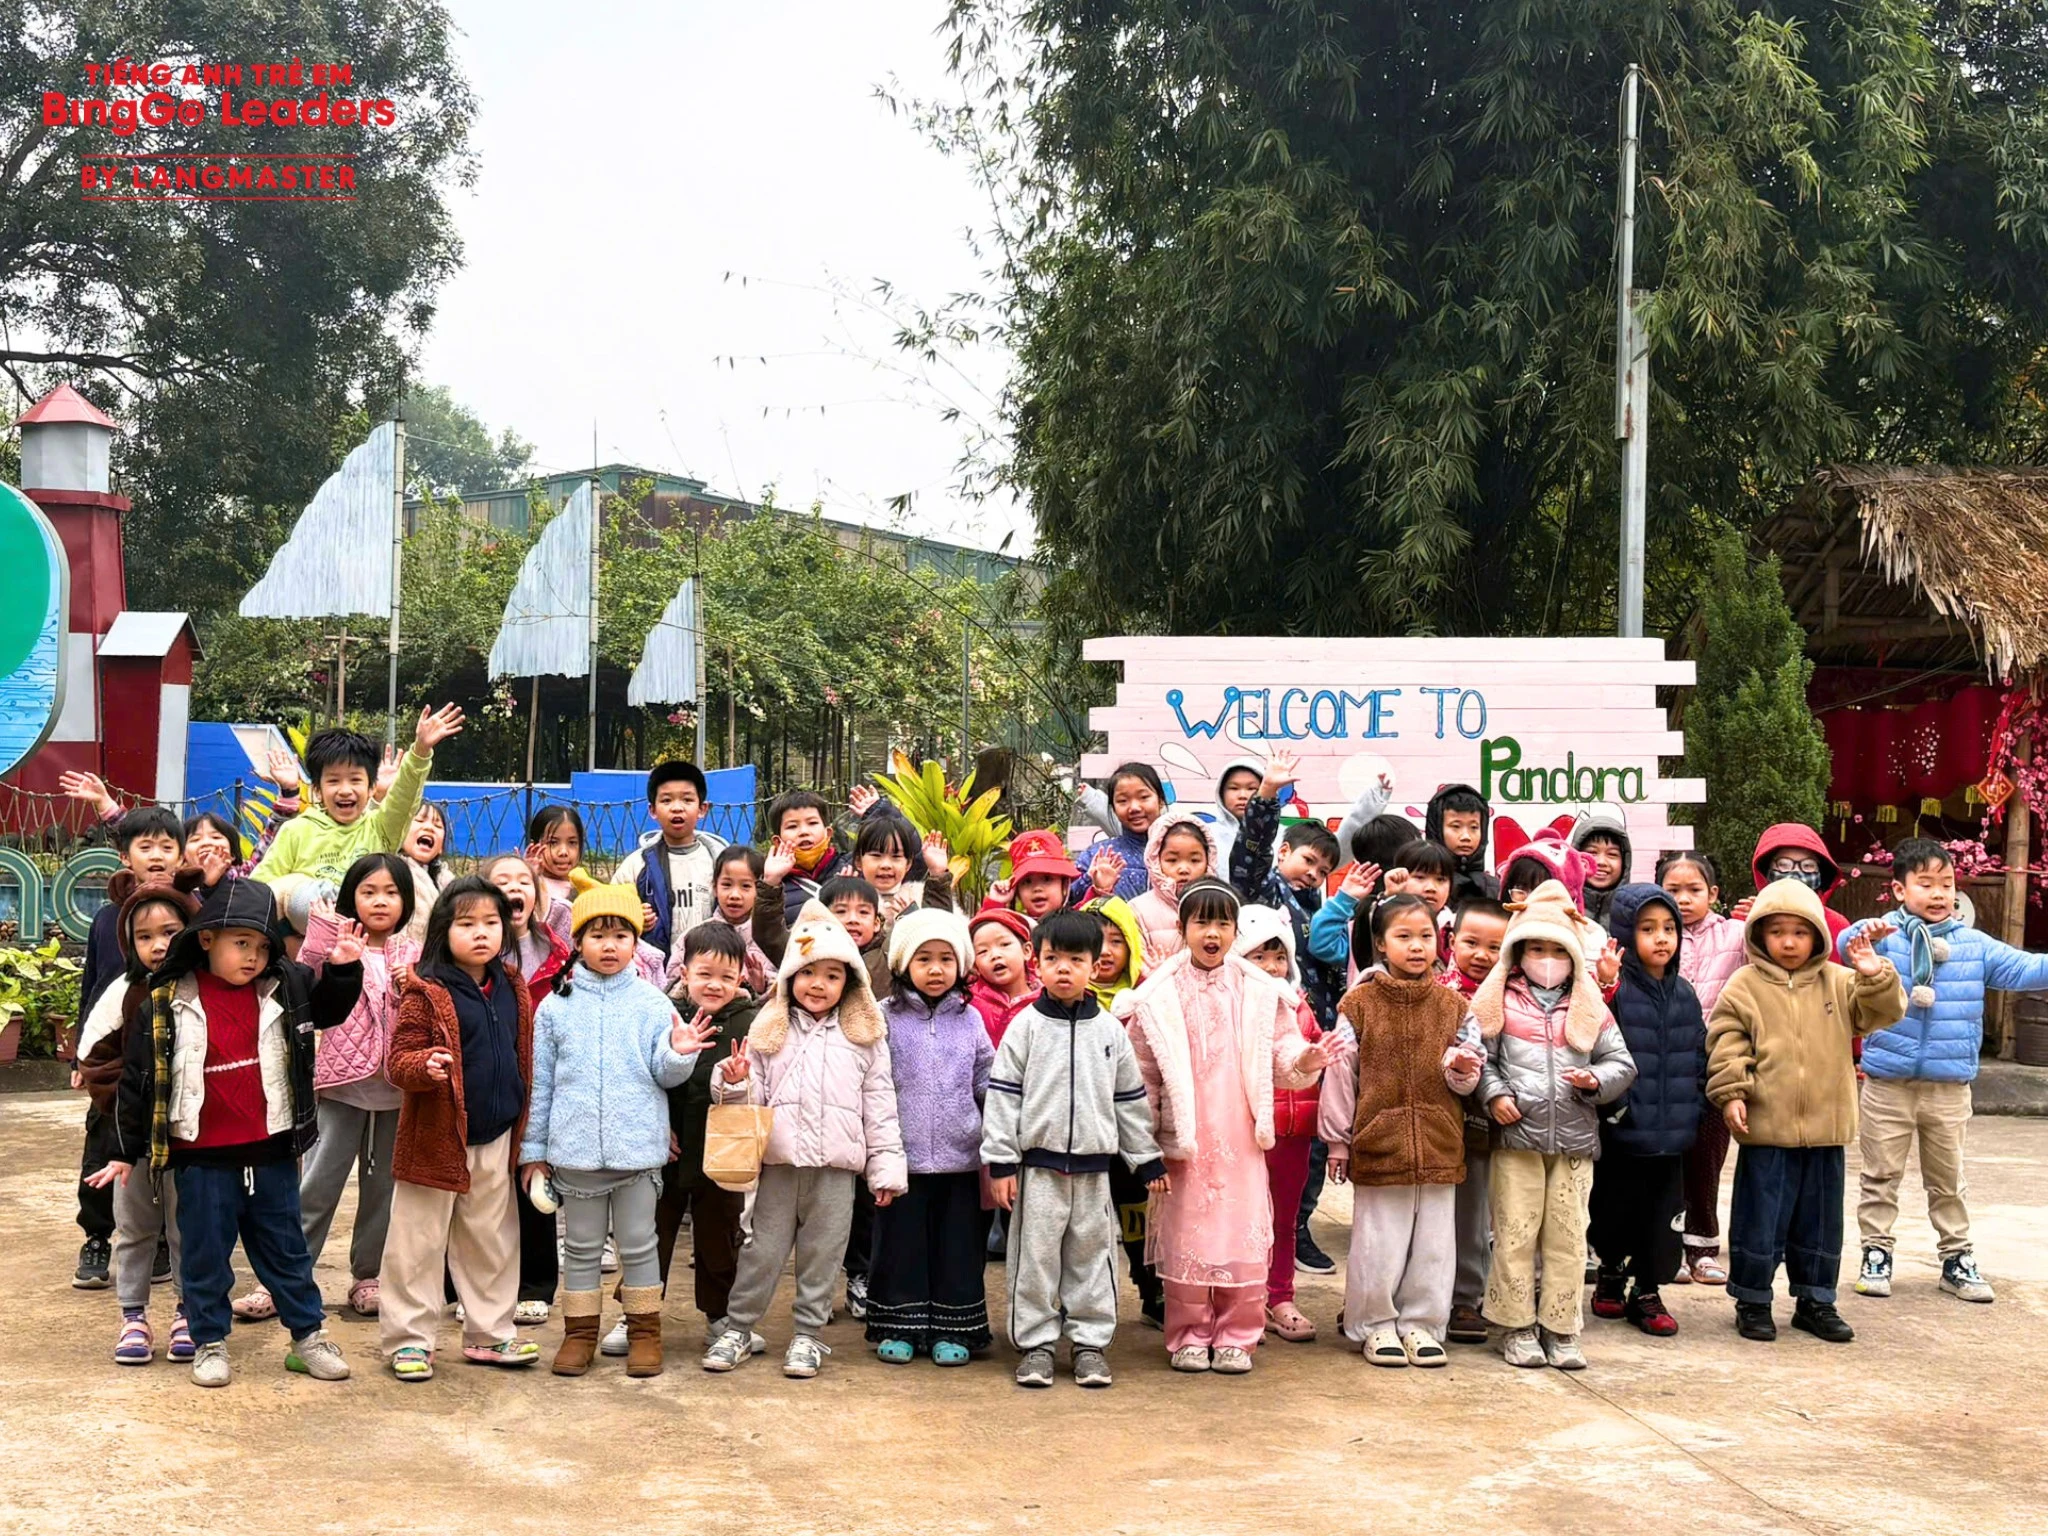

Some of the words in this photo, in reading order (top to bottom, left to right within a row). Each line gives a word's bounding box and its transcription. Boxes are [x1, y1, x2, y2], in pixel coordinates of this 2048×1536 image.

[1166, 686, 1402, 740] WELCOME
[1420, 687, 1488, 740] TO
[1480, 736, 1649, 803] Pandora
